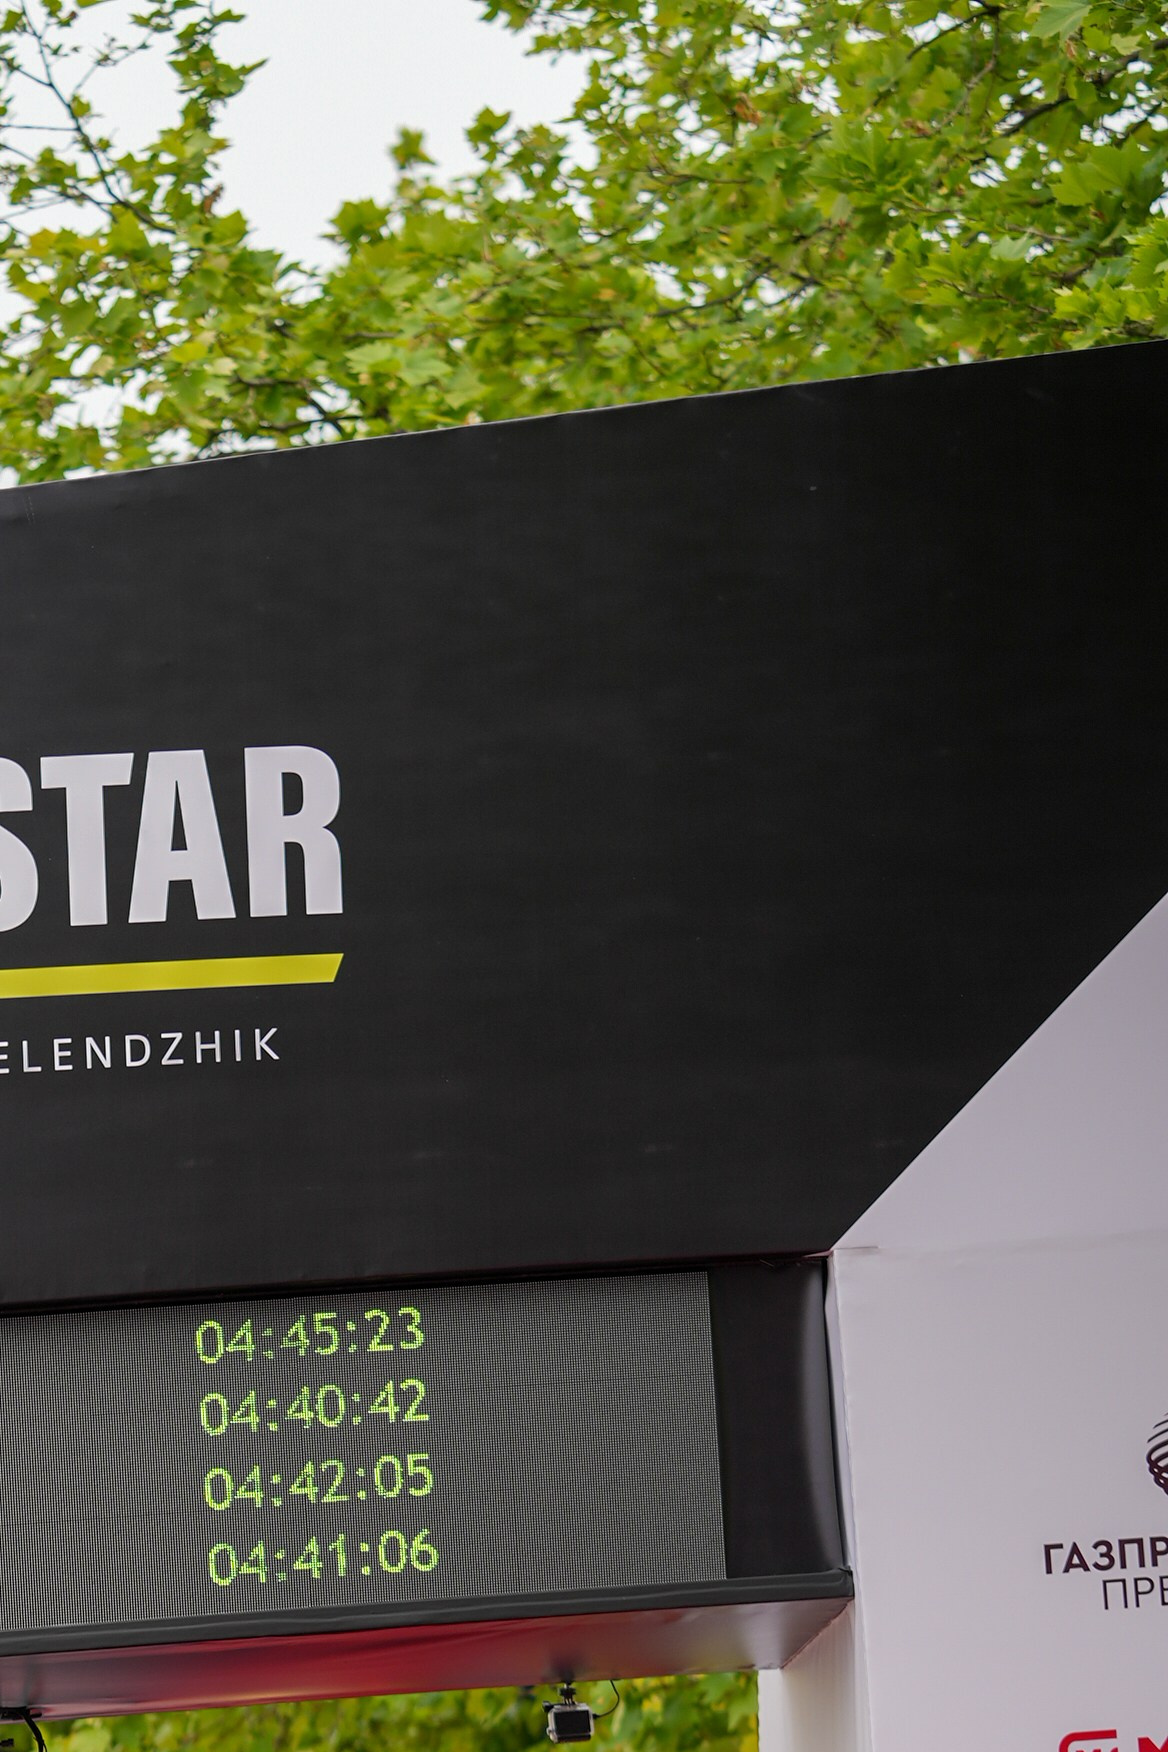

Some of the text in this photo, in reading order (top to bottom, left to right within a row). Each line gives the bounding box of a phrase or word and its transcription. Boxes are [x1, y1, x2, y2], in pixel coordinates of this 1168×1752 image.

[196, 1306, 425, 1364] 04:45:23
[200, 1378, 429, 1436] 04:40:42
[204, 1453, 434, 1510] 04:42:05
[208, 1529, 439, 1586] 04:41:06
